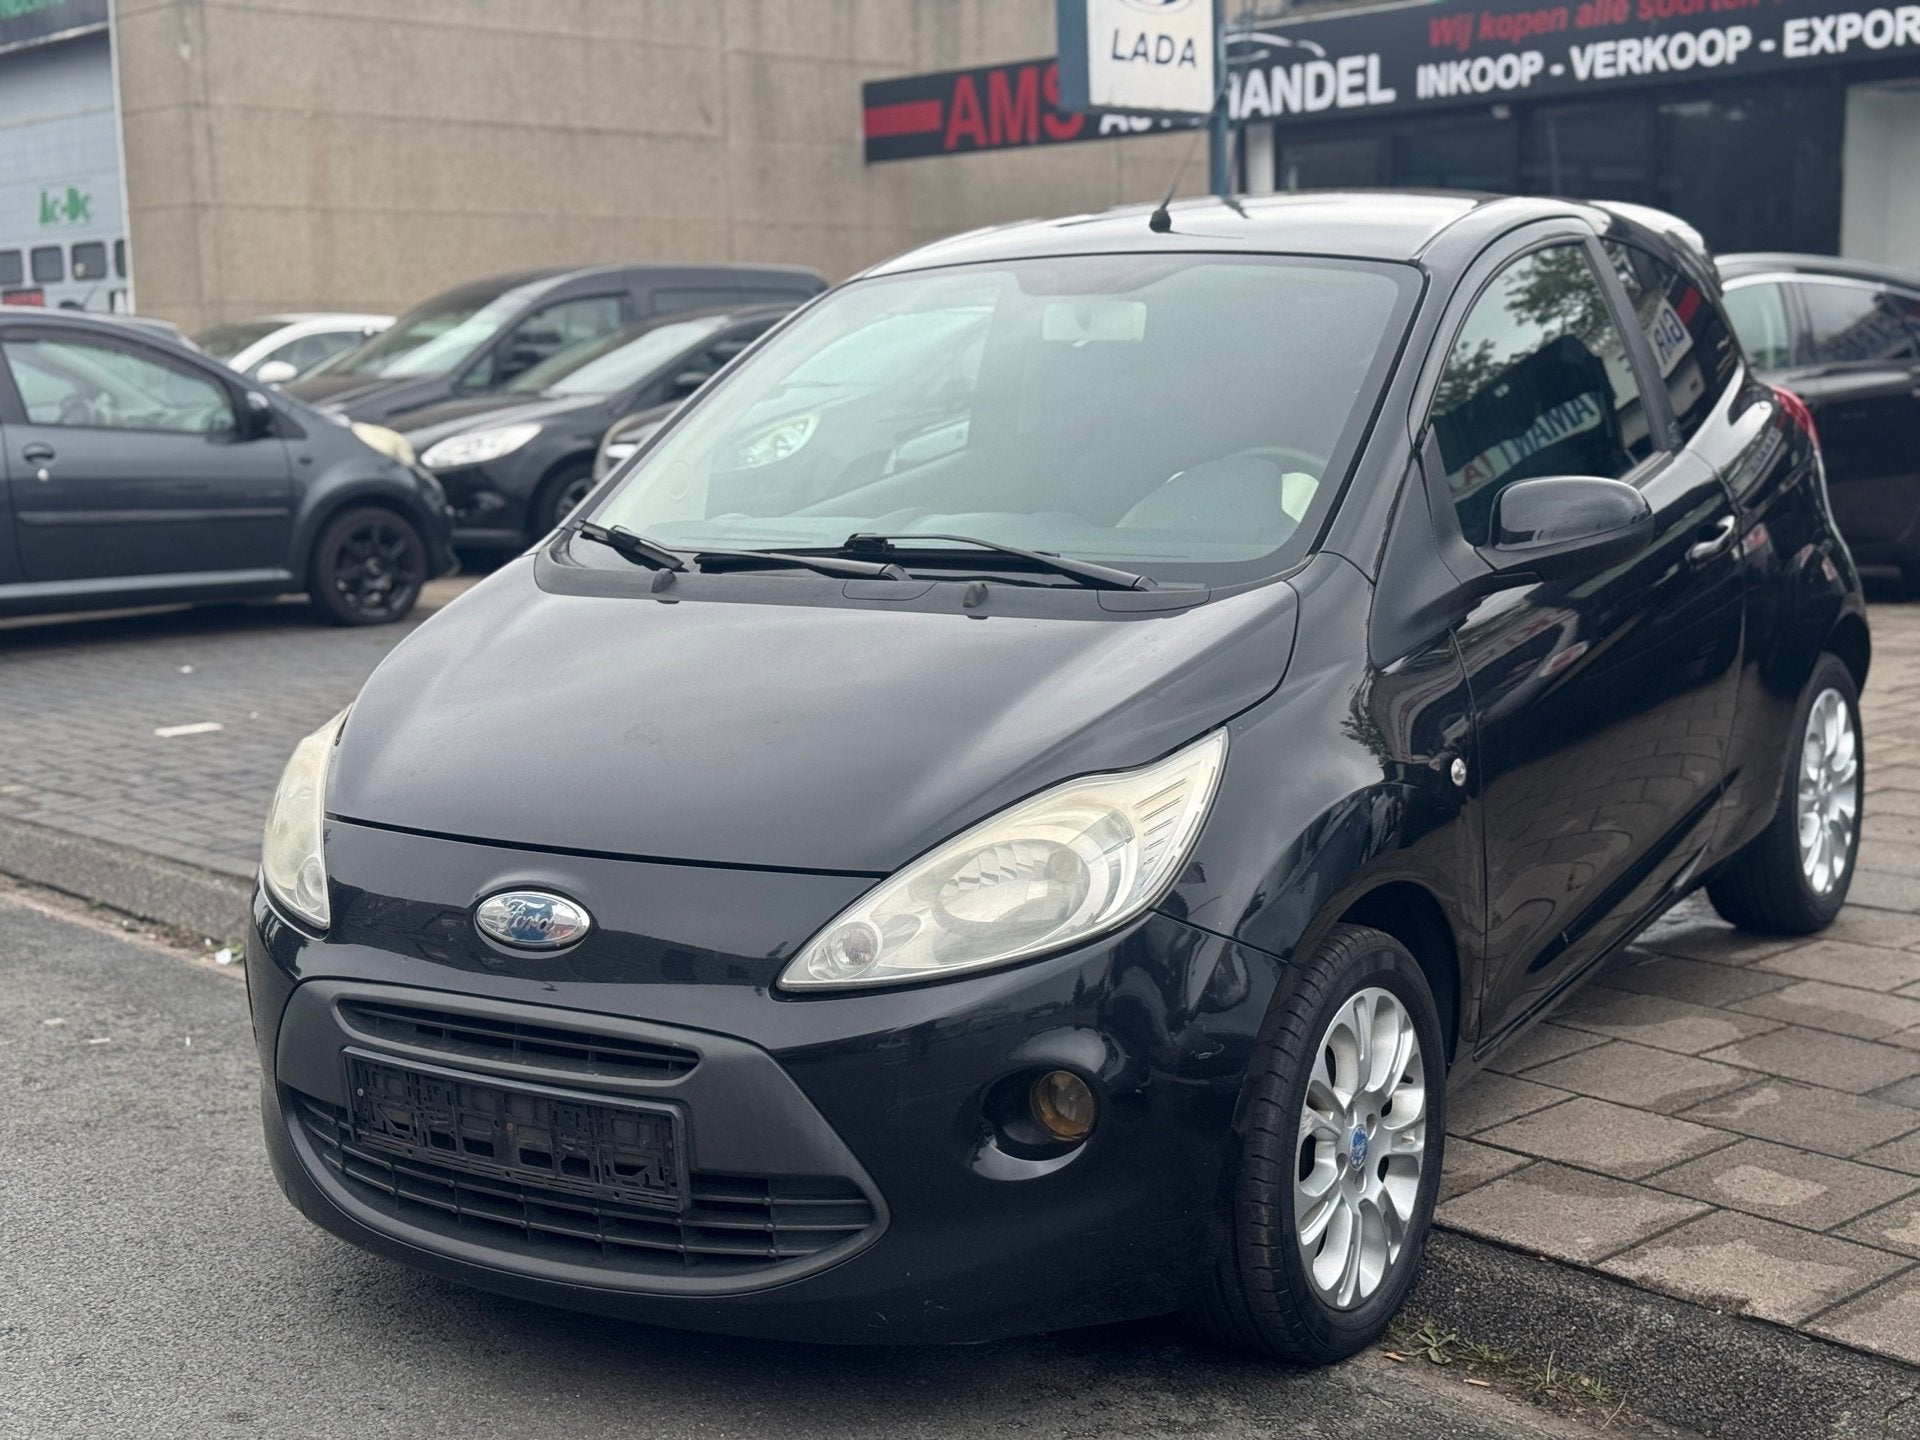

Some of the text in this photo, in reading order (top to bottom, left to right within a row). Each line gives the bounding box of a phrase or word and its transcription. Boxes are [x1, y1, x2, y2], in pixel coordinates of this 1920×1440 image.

[1112, 29, 1196, 68] LADA
[1416, 50, 1544, 99] INKOOP
[1569, 25, 1752, 81] VERKOOP
[1783, 5, 1920, 58] EXPOR
[1429, 12, 1473, 52] Wij
[1478, 8, 1569, 44] kopen
